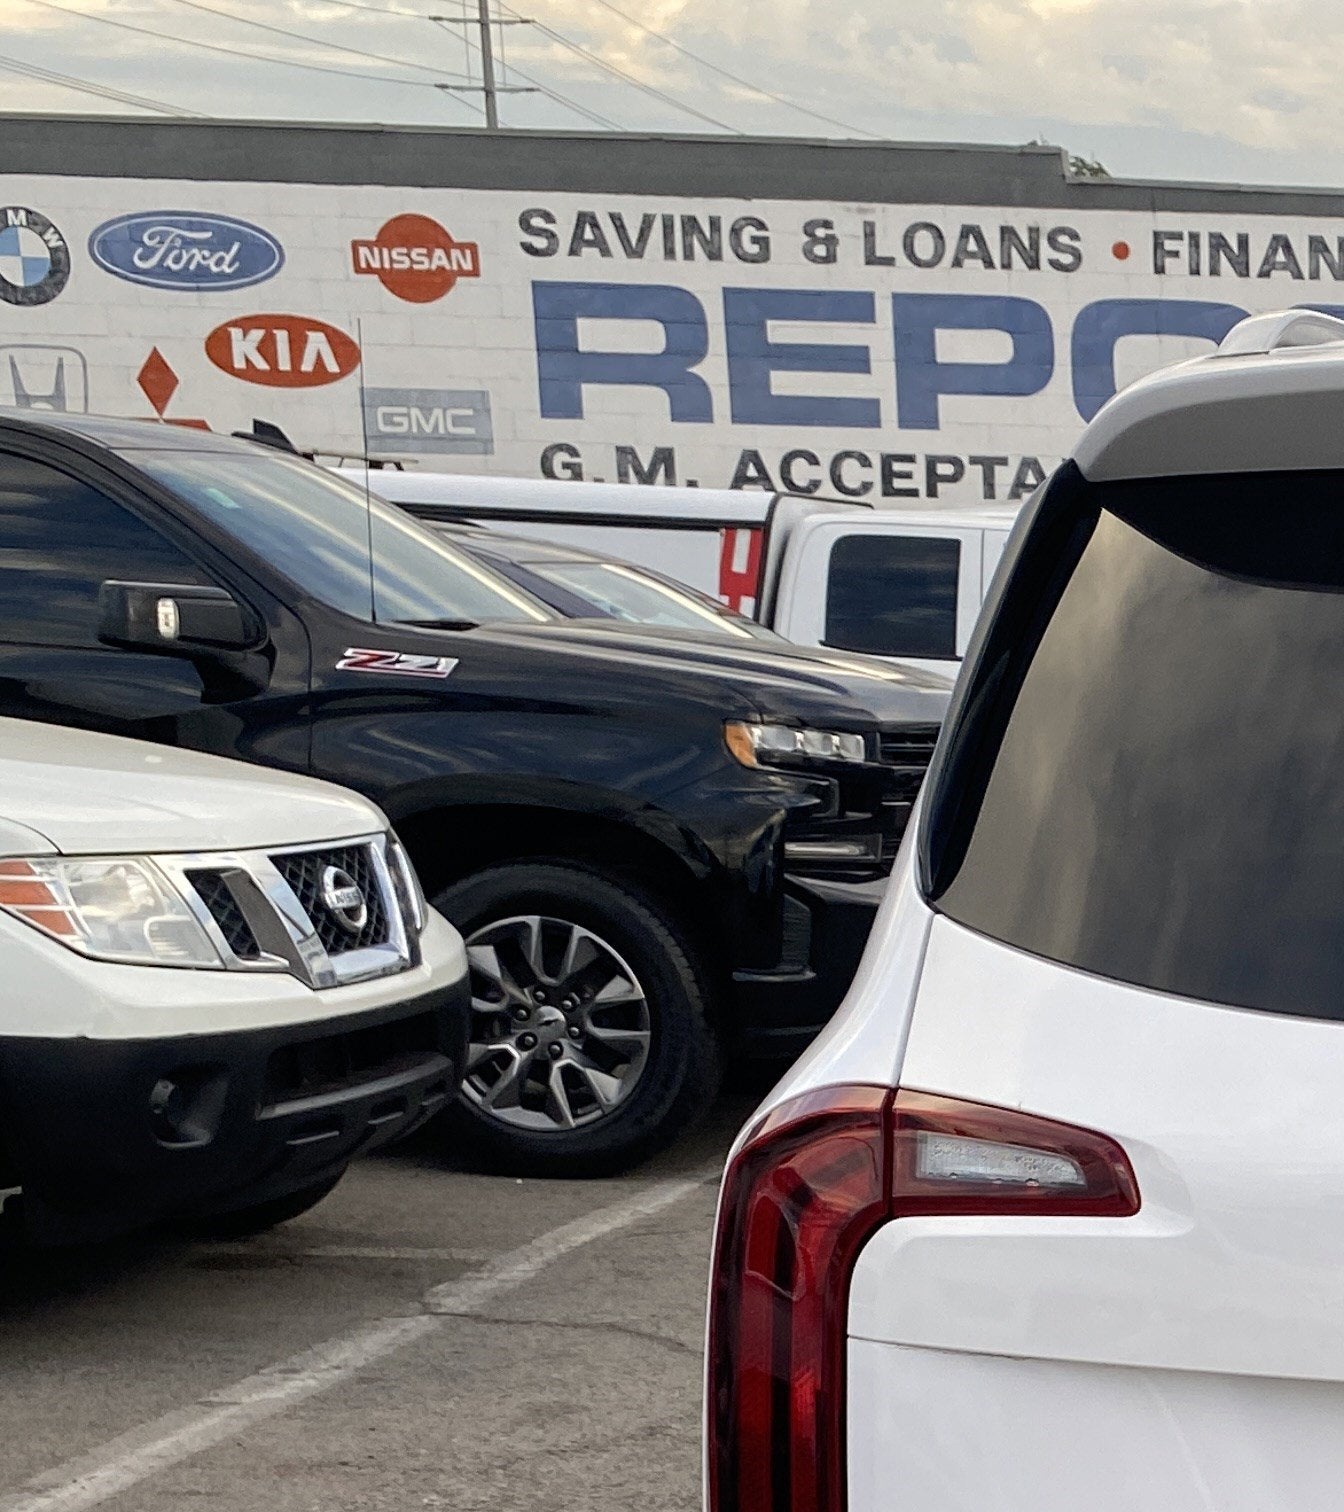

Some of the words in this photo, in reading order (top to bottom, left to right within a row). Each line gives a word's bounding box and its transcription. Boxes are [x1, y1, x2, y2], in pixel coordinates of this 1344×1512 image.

[132, 226, 242, 274] Ford
[358, 245, 474, 272] NISSAN
[518, 208, 772, 264] SAVING
[802, 218, 840, 263] &
[863, 220, 1083, 273] LOANS
[227, 326, 341, 374] KIA
[374, 405, 477, 435] GMC
[540, 443, 700, 488] G.M.
[730, 448, 1066, 500] ACCEPTA
[335, 647, 460, 679] Z71
